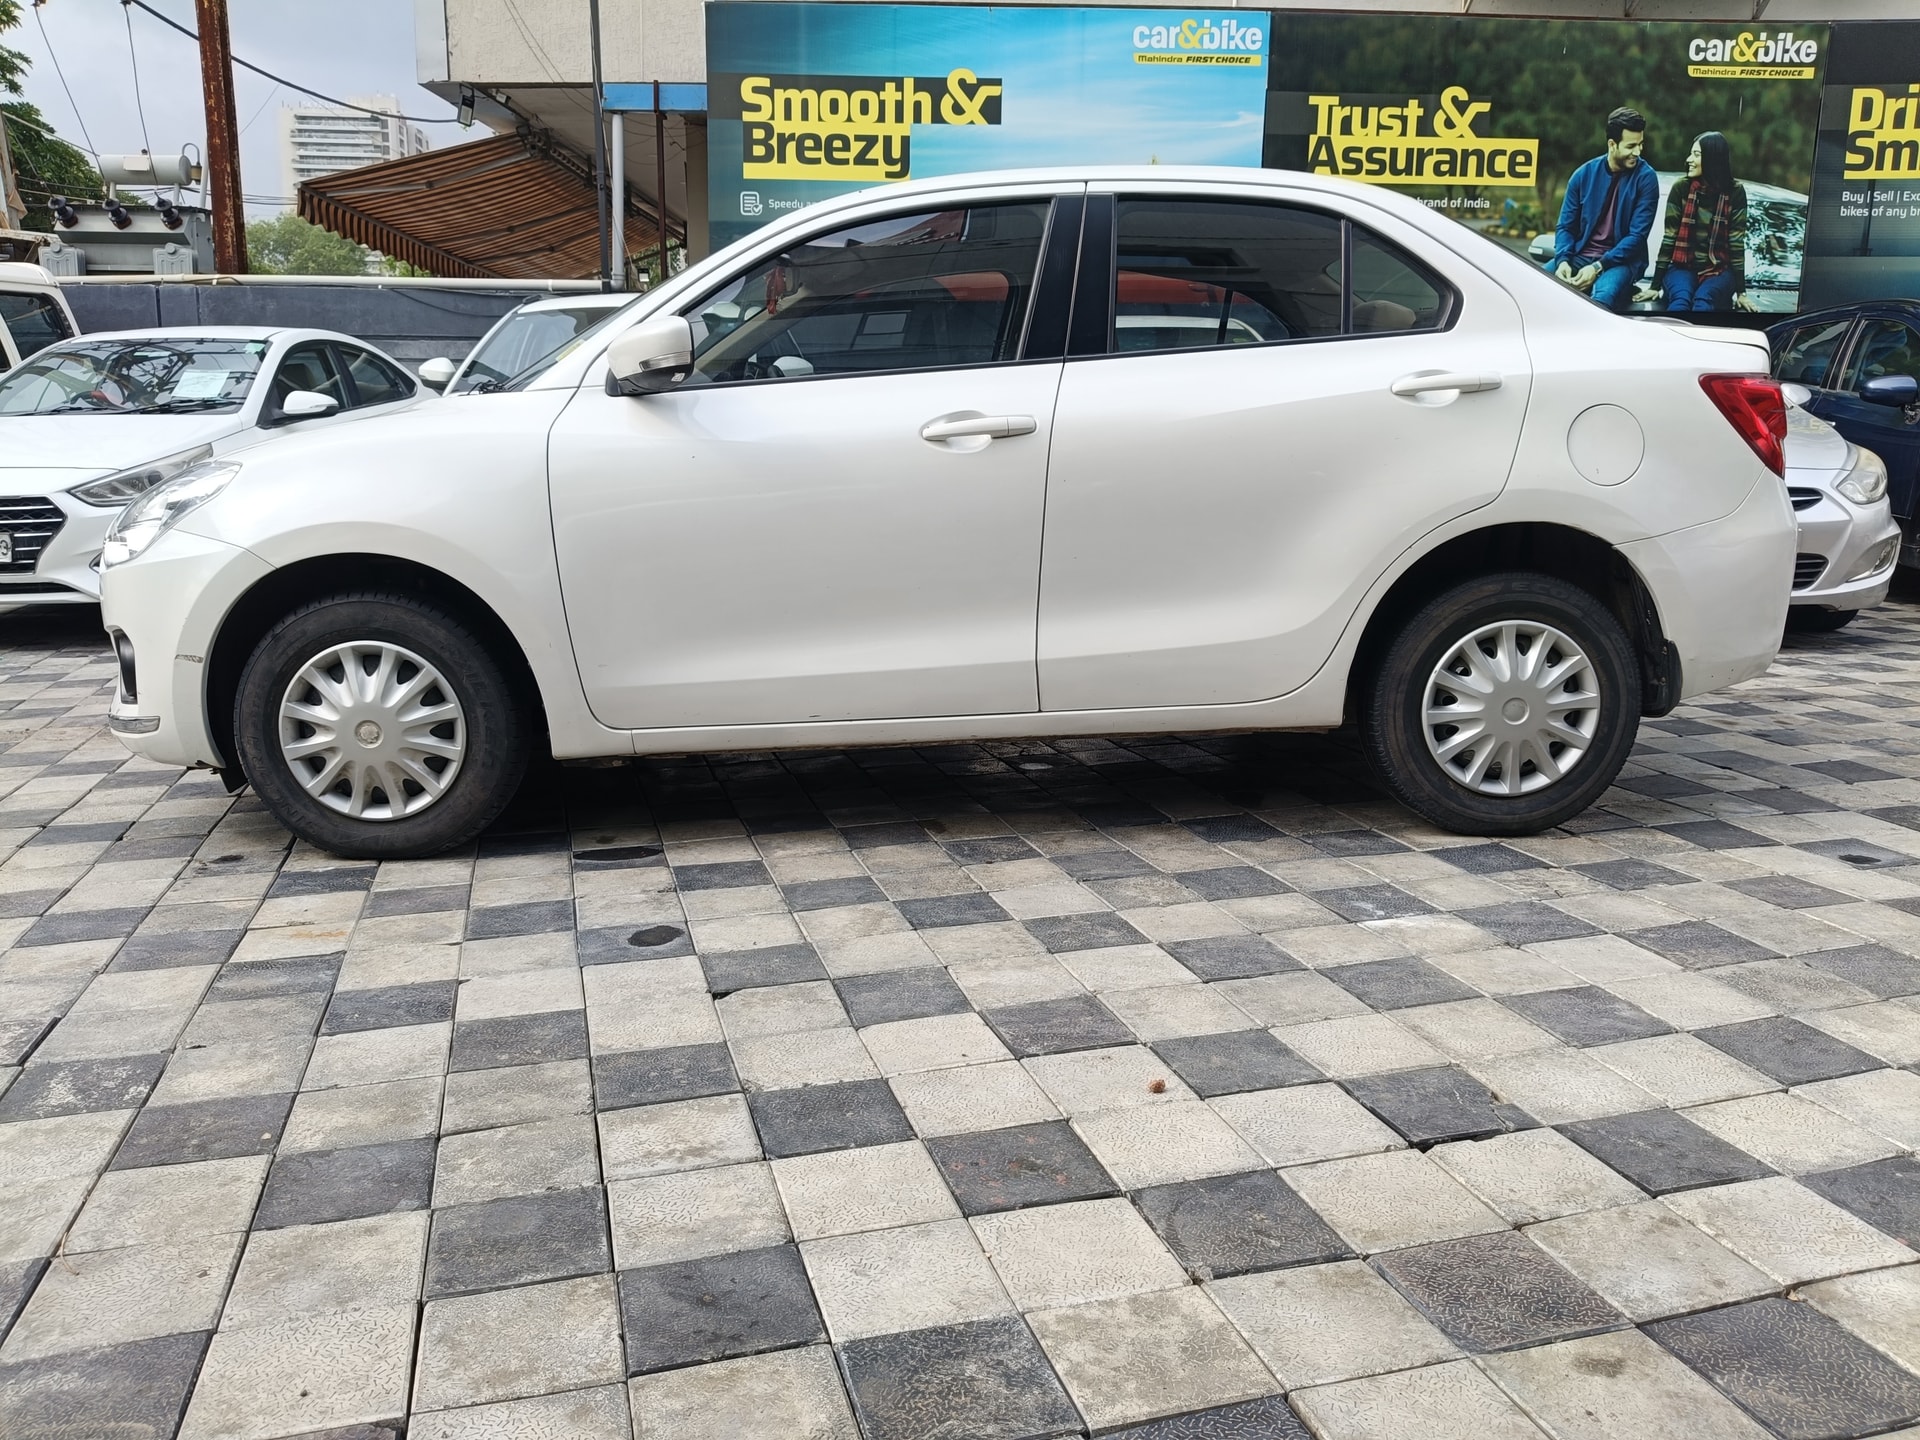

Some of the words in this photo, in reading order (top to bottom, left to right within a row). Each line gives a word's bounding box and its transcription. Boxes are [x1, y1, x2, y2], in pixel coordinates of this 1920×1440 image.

[1133, 18, 1263, 50] car&bike
[1688, 32, 1818, 63] car&bike
[1138, 55, 1183, 63] Mahindra
[1215, 56, 1252, 64] CHOICE
[1692, 67, 1736, 75] Mahindra
[740, 76, 932, 125] Smooth
[940, 68, 1002, 125] &
[1308, 95, 1424, 138] Trust
[1433, 86, 1492, 138] &
[742, 121, 911, 179] Breezy
[1308, 135, 1533, 179] Assurance
[1450, 197, 1462, 208] of
[1464, 197, 1490, 209] India
[1840, 205, 1869, 217] bikes
[1871, 205, 1884, 217] of
[1886, 208, 1907, 219] any
[1842, 190, 1864, 204] Buy
[1873, 190, 1894, 202] Sell
